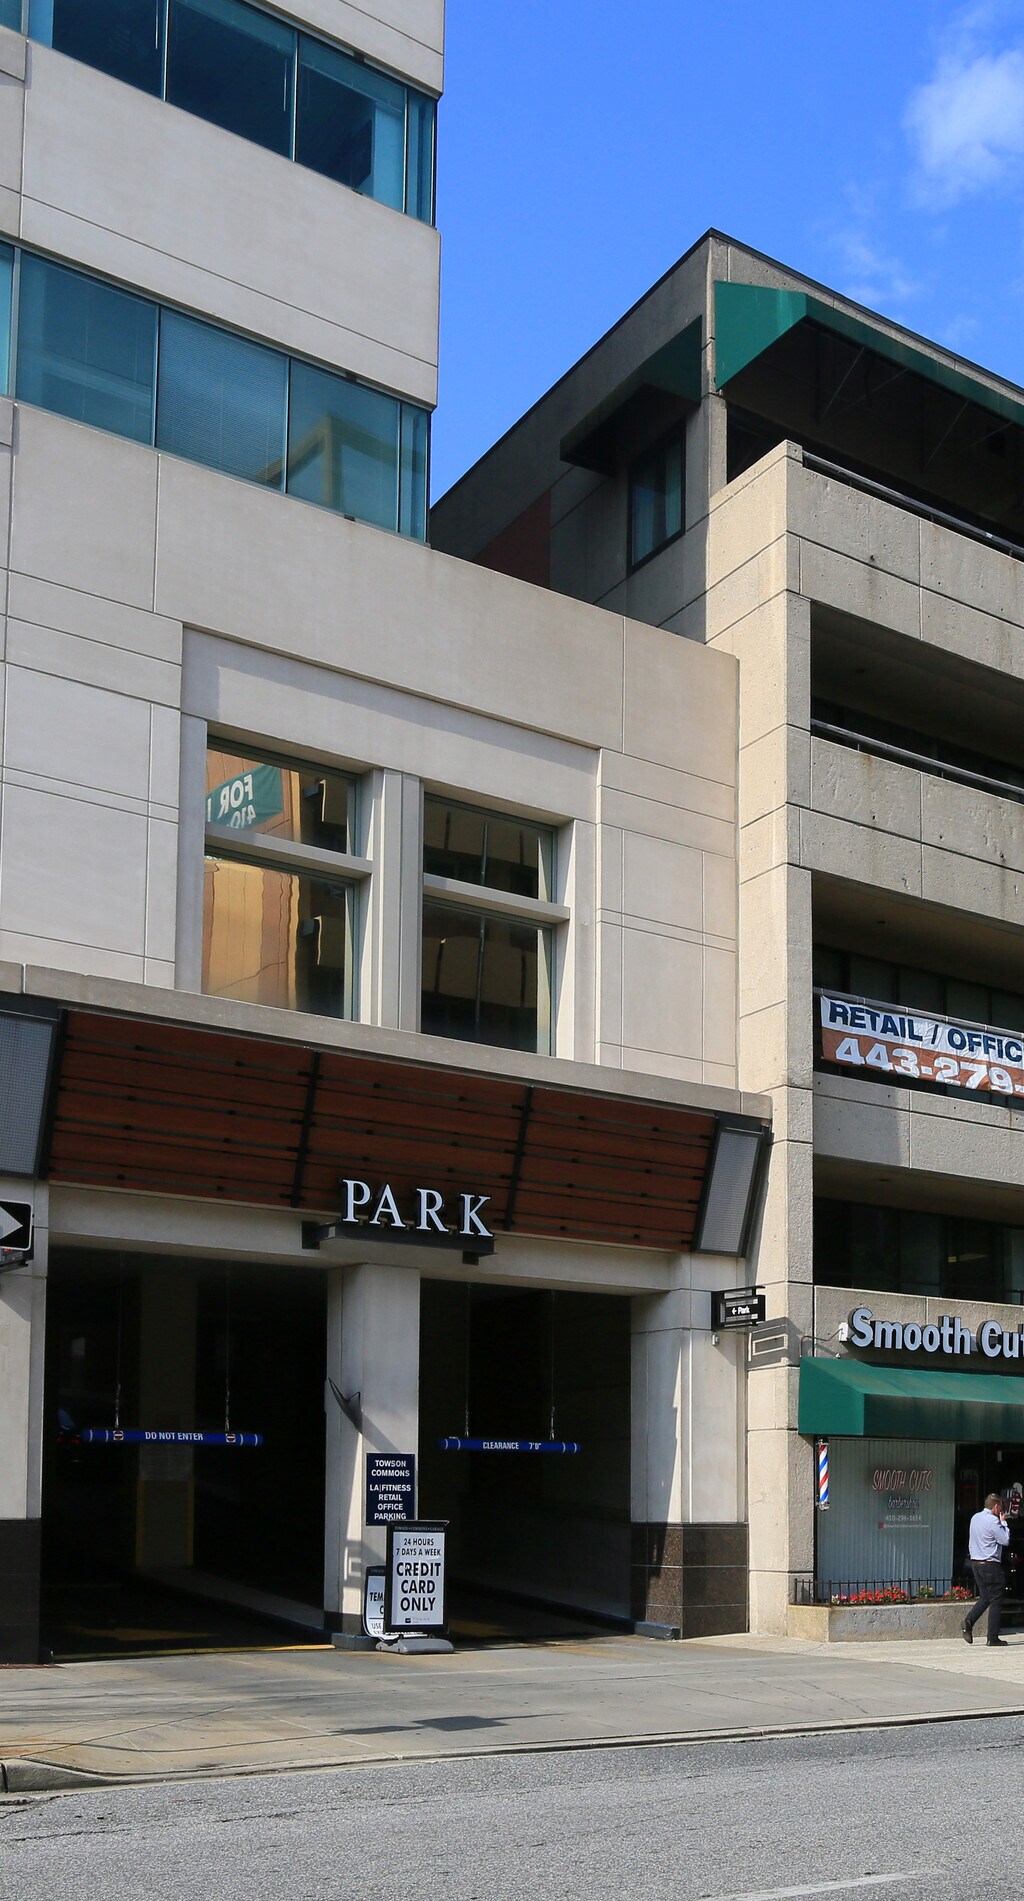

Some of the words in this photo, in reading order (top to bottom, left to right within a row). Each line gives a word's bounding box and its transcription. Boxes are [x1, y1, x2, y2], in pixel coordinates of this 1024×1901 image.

[829, 1002, 923, 1042] RETAIL
[342, 1179, 494, 1237] PARK
[737, 1306, 750, 1315] Park
[850, 1307, 972, 1355] Smooth
[145, 1431, 157, 1440] DO
[159, 1431, 175, 1441] NOT
[177, 1432, 203, 1441] ENTER
[482, 1441, 519, 1450] CLEARANCE
[375, 1459, 407, 1468] TOWSON
[371, 1469, 410, 1477] COMMONS
[872, 1469, 908, 1491] SMOOTH
[909, 1469, 934, 1491] CUTS
[378, 1493, 403, 1501] RETAIL
[377, 1503, 404, 1511] OFFICE
[374, 1512, 407, 1520] PARKING
[404, 1538, 411, 1546] 24
[412, 1538, 434, 1546] HOURS
[396, 1548, 400, 1556] 7
[401, 1548, 417, 1556] DAYS
[418, 1548, 423, 1556] A
[424, 1548, 441, 1556] WEEK
[396, 1562, 441, 1577] CREDIT
[401, 1579, 436, 1594] CARD
[400, 1597, 436, 1612] ONLY
